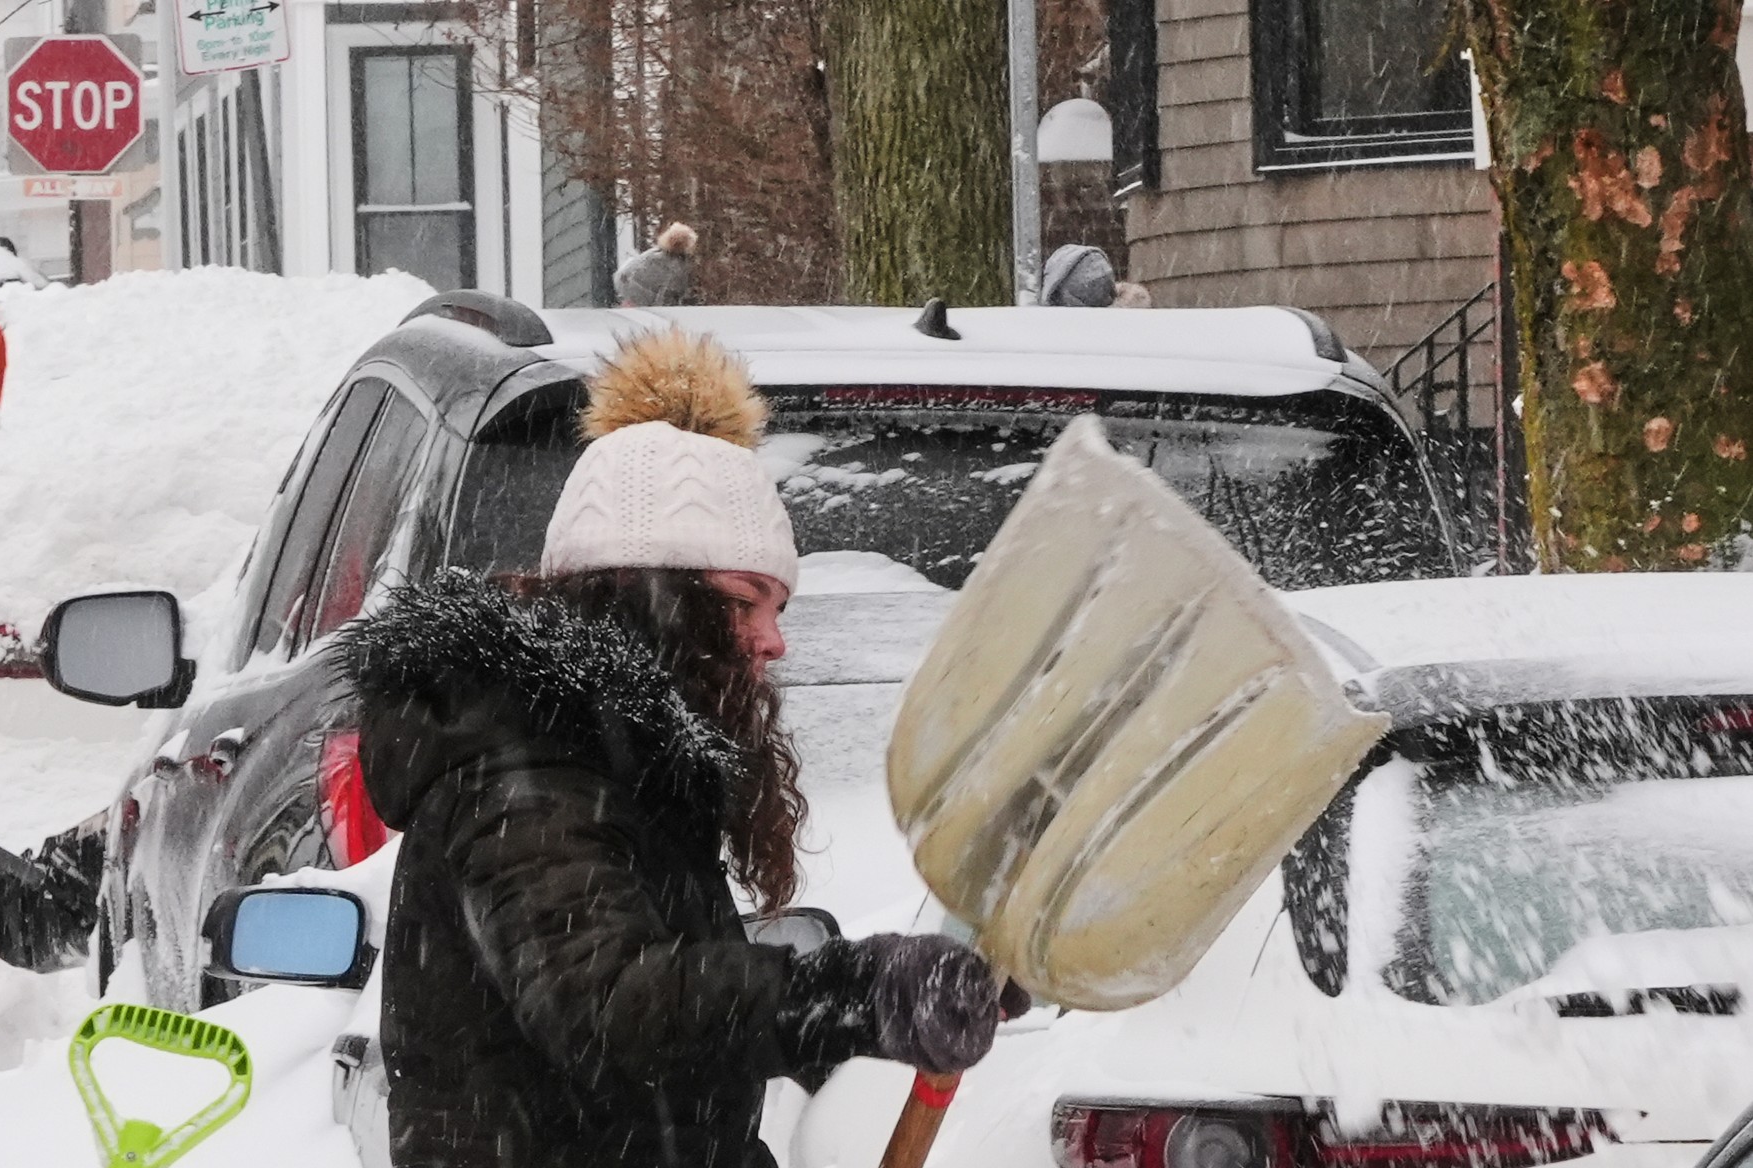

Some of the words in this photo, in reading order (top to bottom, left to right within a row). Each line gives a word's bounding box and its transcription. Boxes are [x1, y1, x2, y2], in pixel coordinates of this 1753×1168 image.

[206, 0, 258, 10] Perm
[204, 12, 265, 31] Parking
[201, 48, 238, 61] Every
[244, 43, 271, 56] Night
[14, 80, 134, 131] STOP
